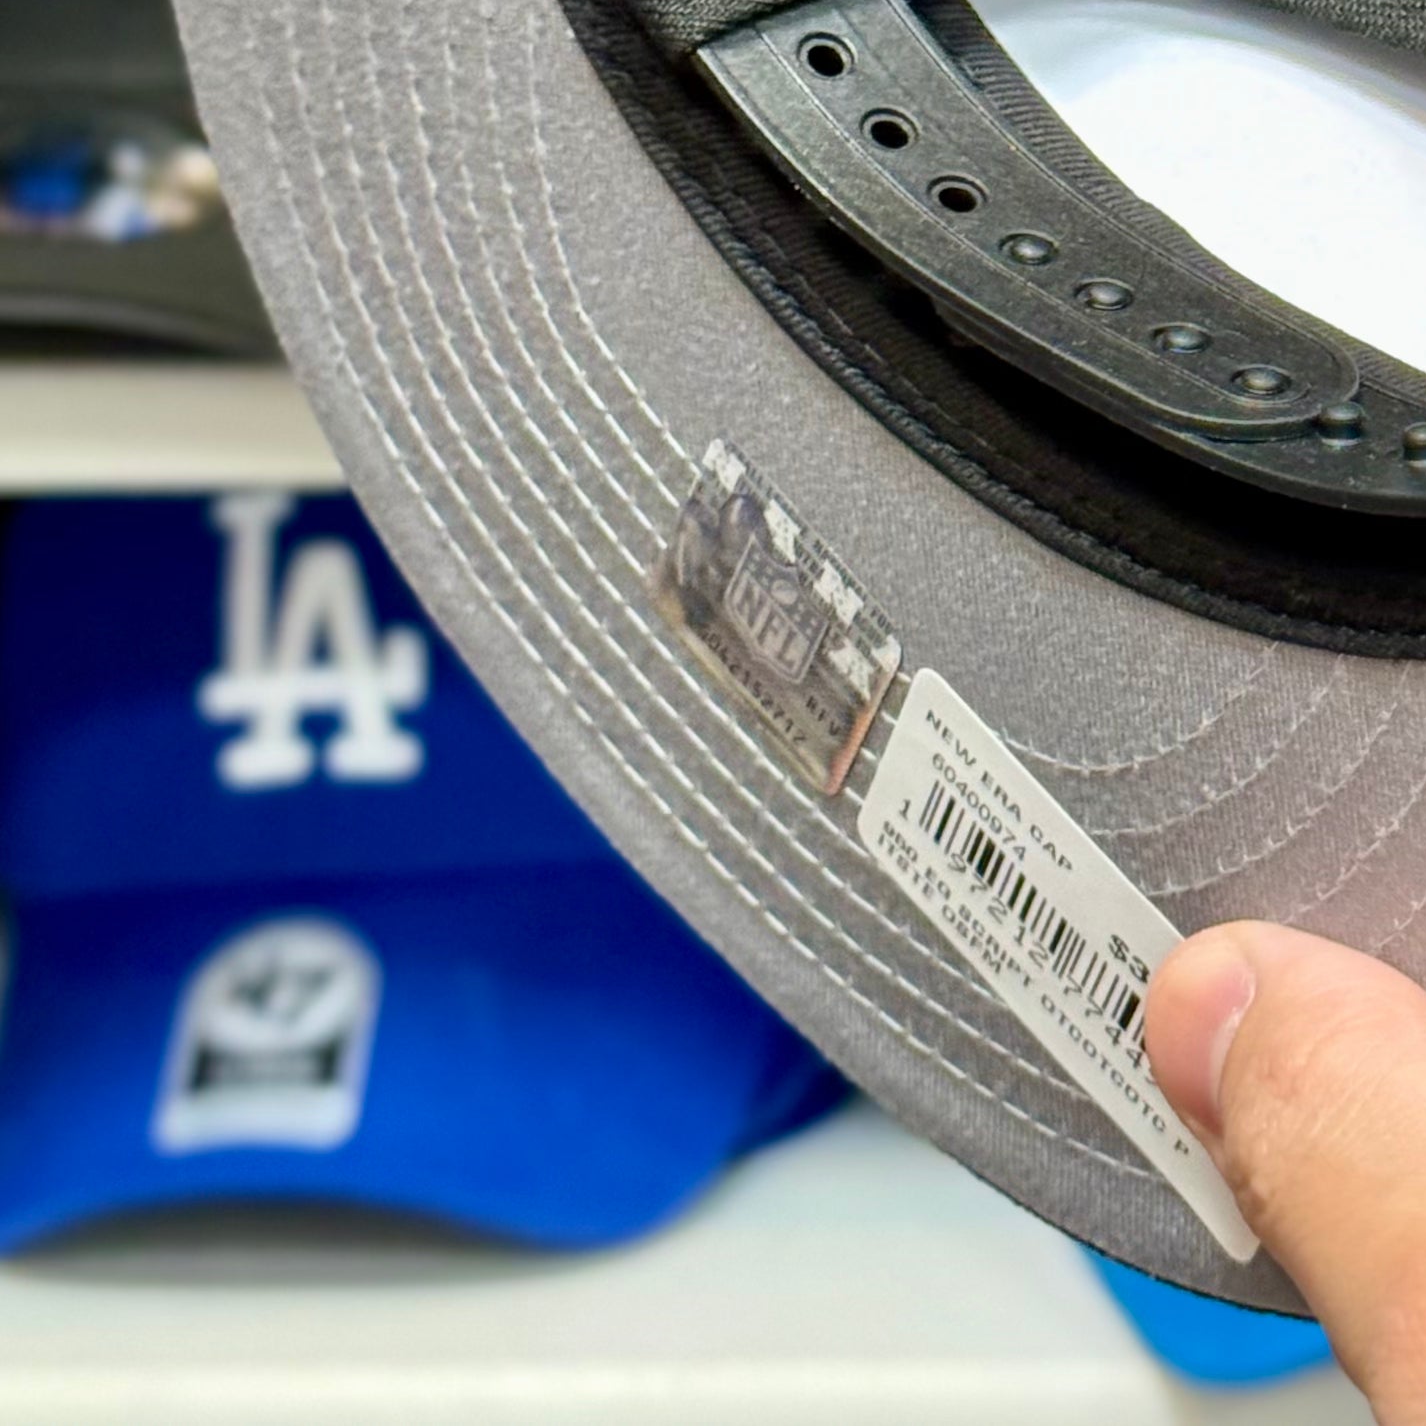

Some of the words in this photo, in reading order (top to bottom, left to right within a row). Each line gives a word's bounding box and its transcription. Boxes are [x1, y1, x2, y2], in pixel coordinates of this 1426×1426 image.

[202, 494, 428, 790] LA
[736, 577, 800, 670] NFL
[926, 710, 977, 767] NEW
[981, 771, 1022, 822] ERA
[1030, 825, 1073, 871] CAP
[932, 753, 1026, 861] 60400974
[942, 904, 1001, 974] OSFM
[959, 904, 1031, 987] SCRIPT
[1174, 1139, 1189, 1155] P
